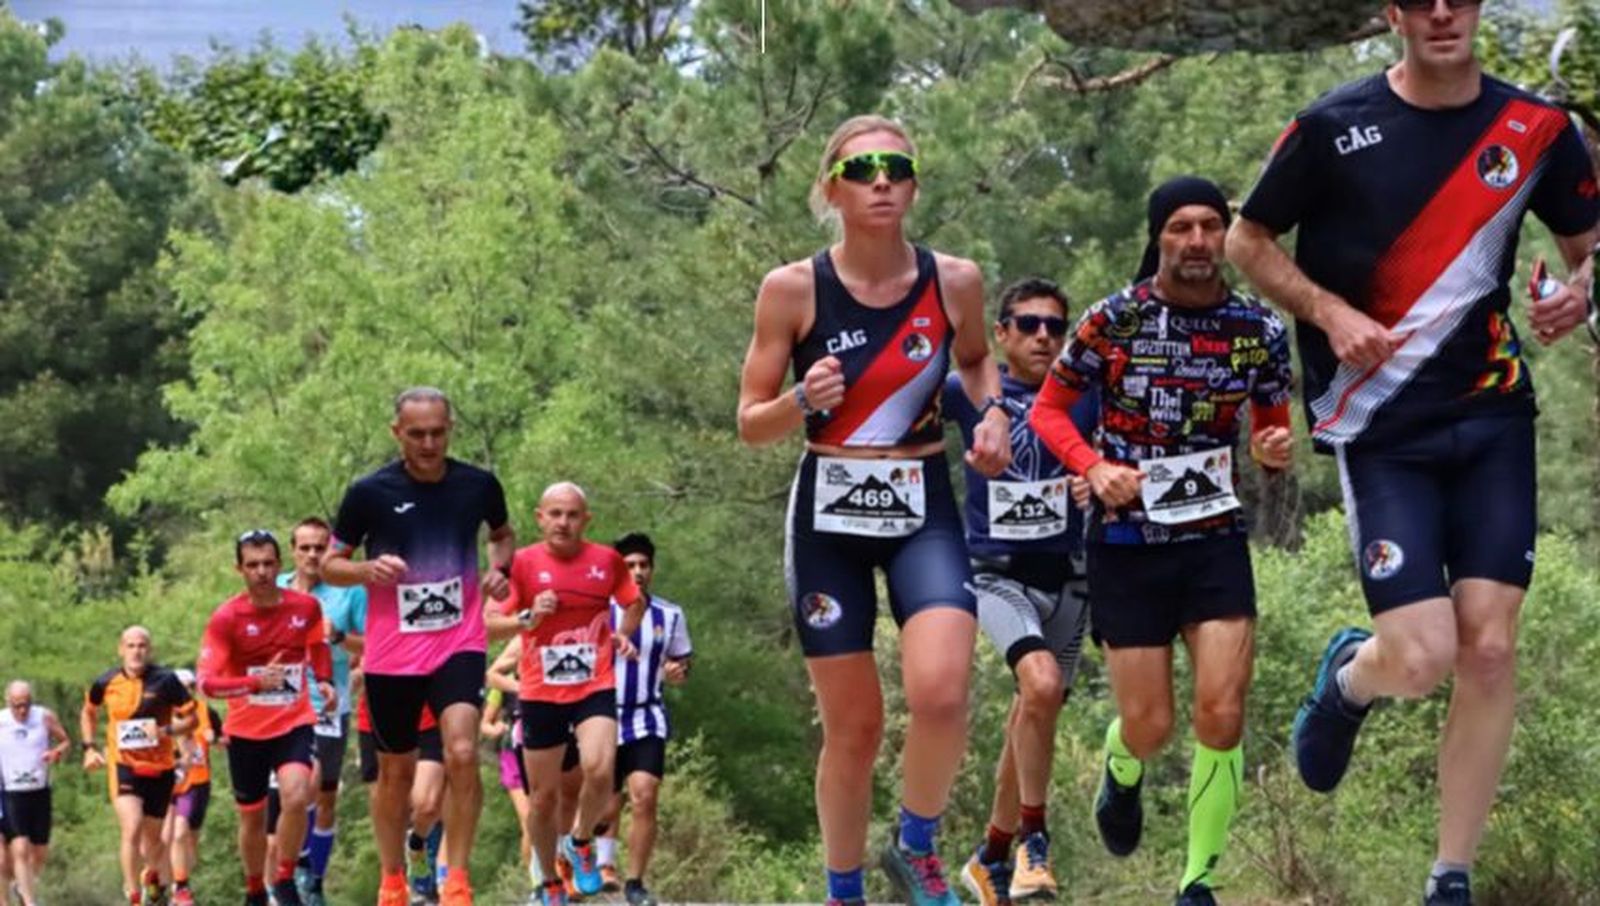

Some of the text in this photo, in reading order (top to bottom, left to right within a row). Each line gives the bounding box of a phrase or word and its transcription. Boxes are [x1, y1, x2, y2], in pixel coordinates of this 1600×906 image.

[1334, 125, 1383, 155] CAG
[826, 329, 867, 354] CAG
[848, 488, 894, 508] 469
[1184, 480, 1198, 496] 9
[1013, 502, 1046, 518] 132
